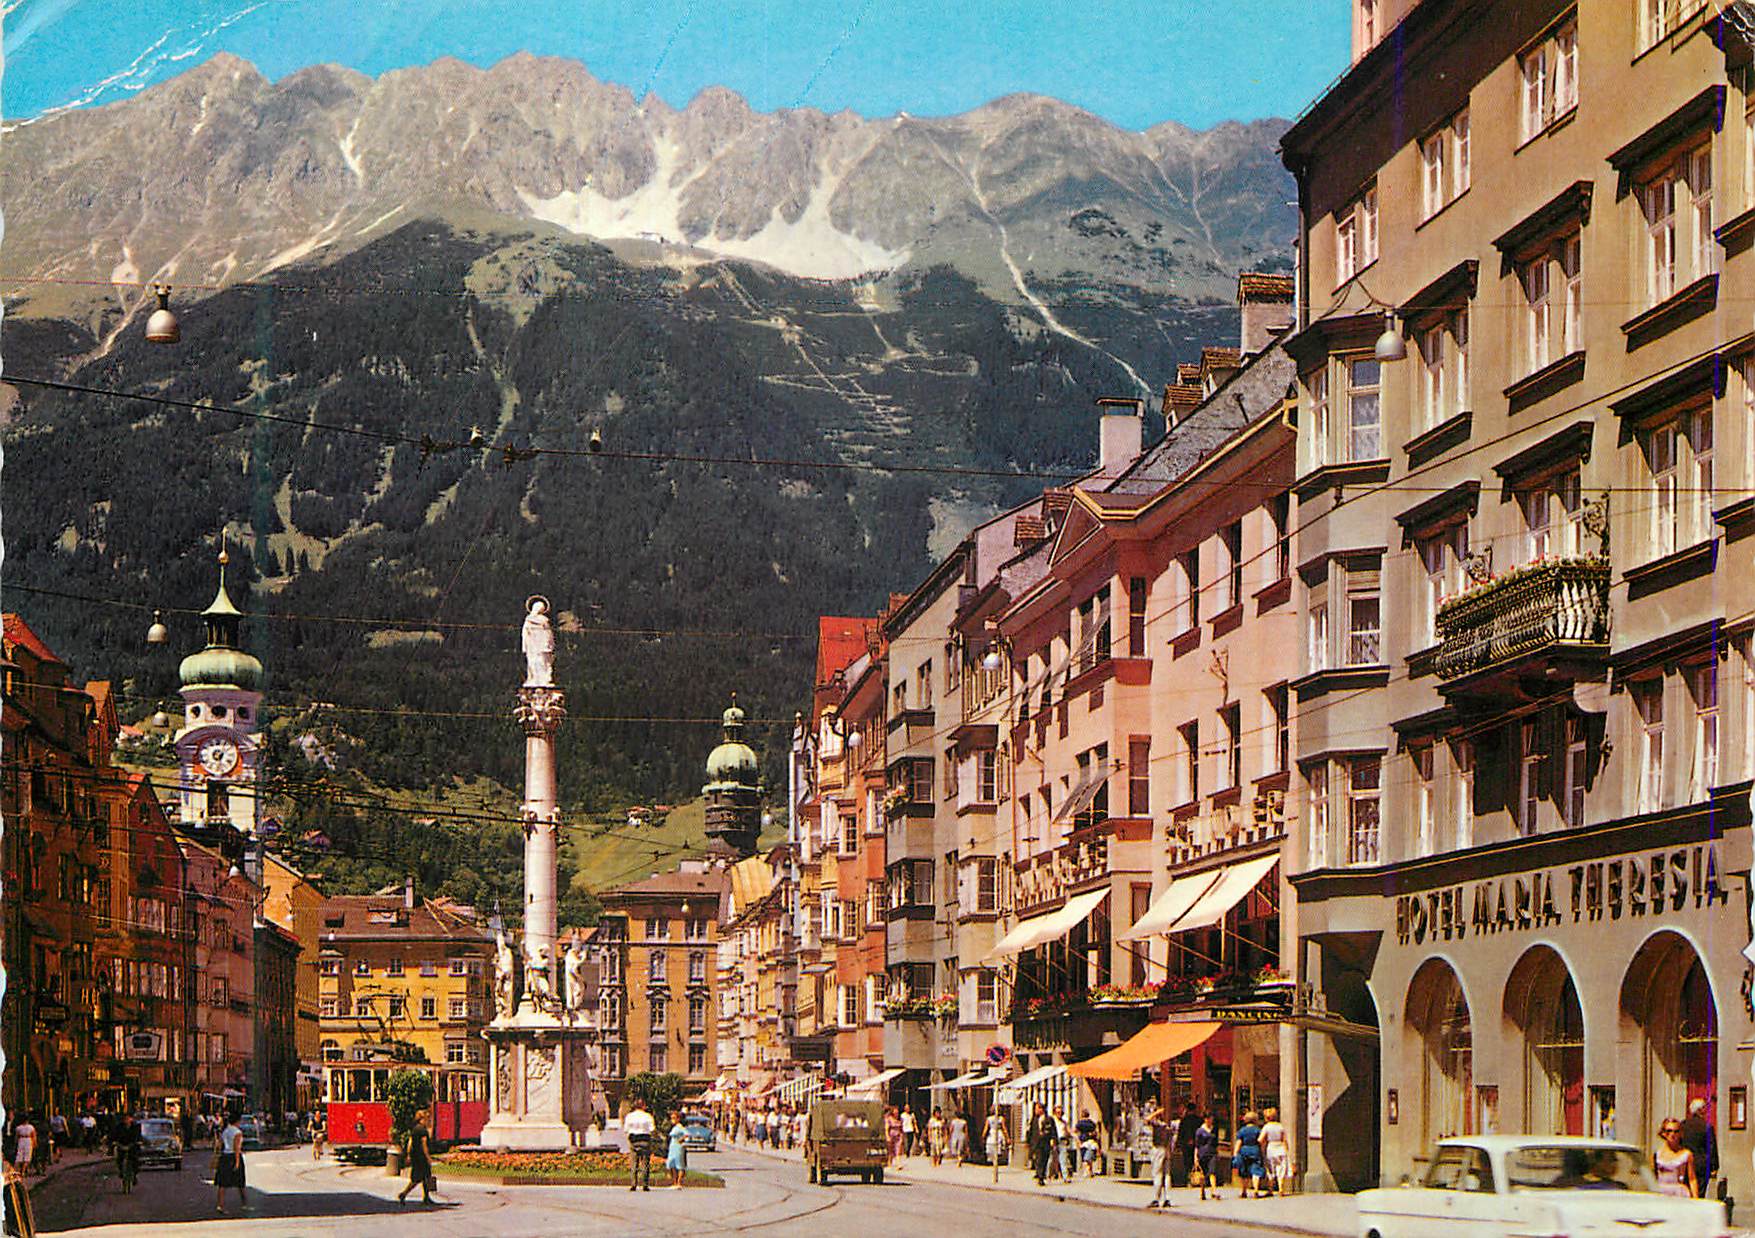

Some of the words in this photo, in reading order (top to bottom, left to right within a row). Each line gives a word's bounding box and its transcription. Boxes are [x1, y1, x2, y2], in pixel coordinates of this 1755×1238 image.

[1397, 887, 1466, 941] HOTEL
[1473, 871, 1561, 932] MARIA
[1569, 844, 1728, 919] THERESIA
